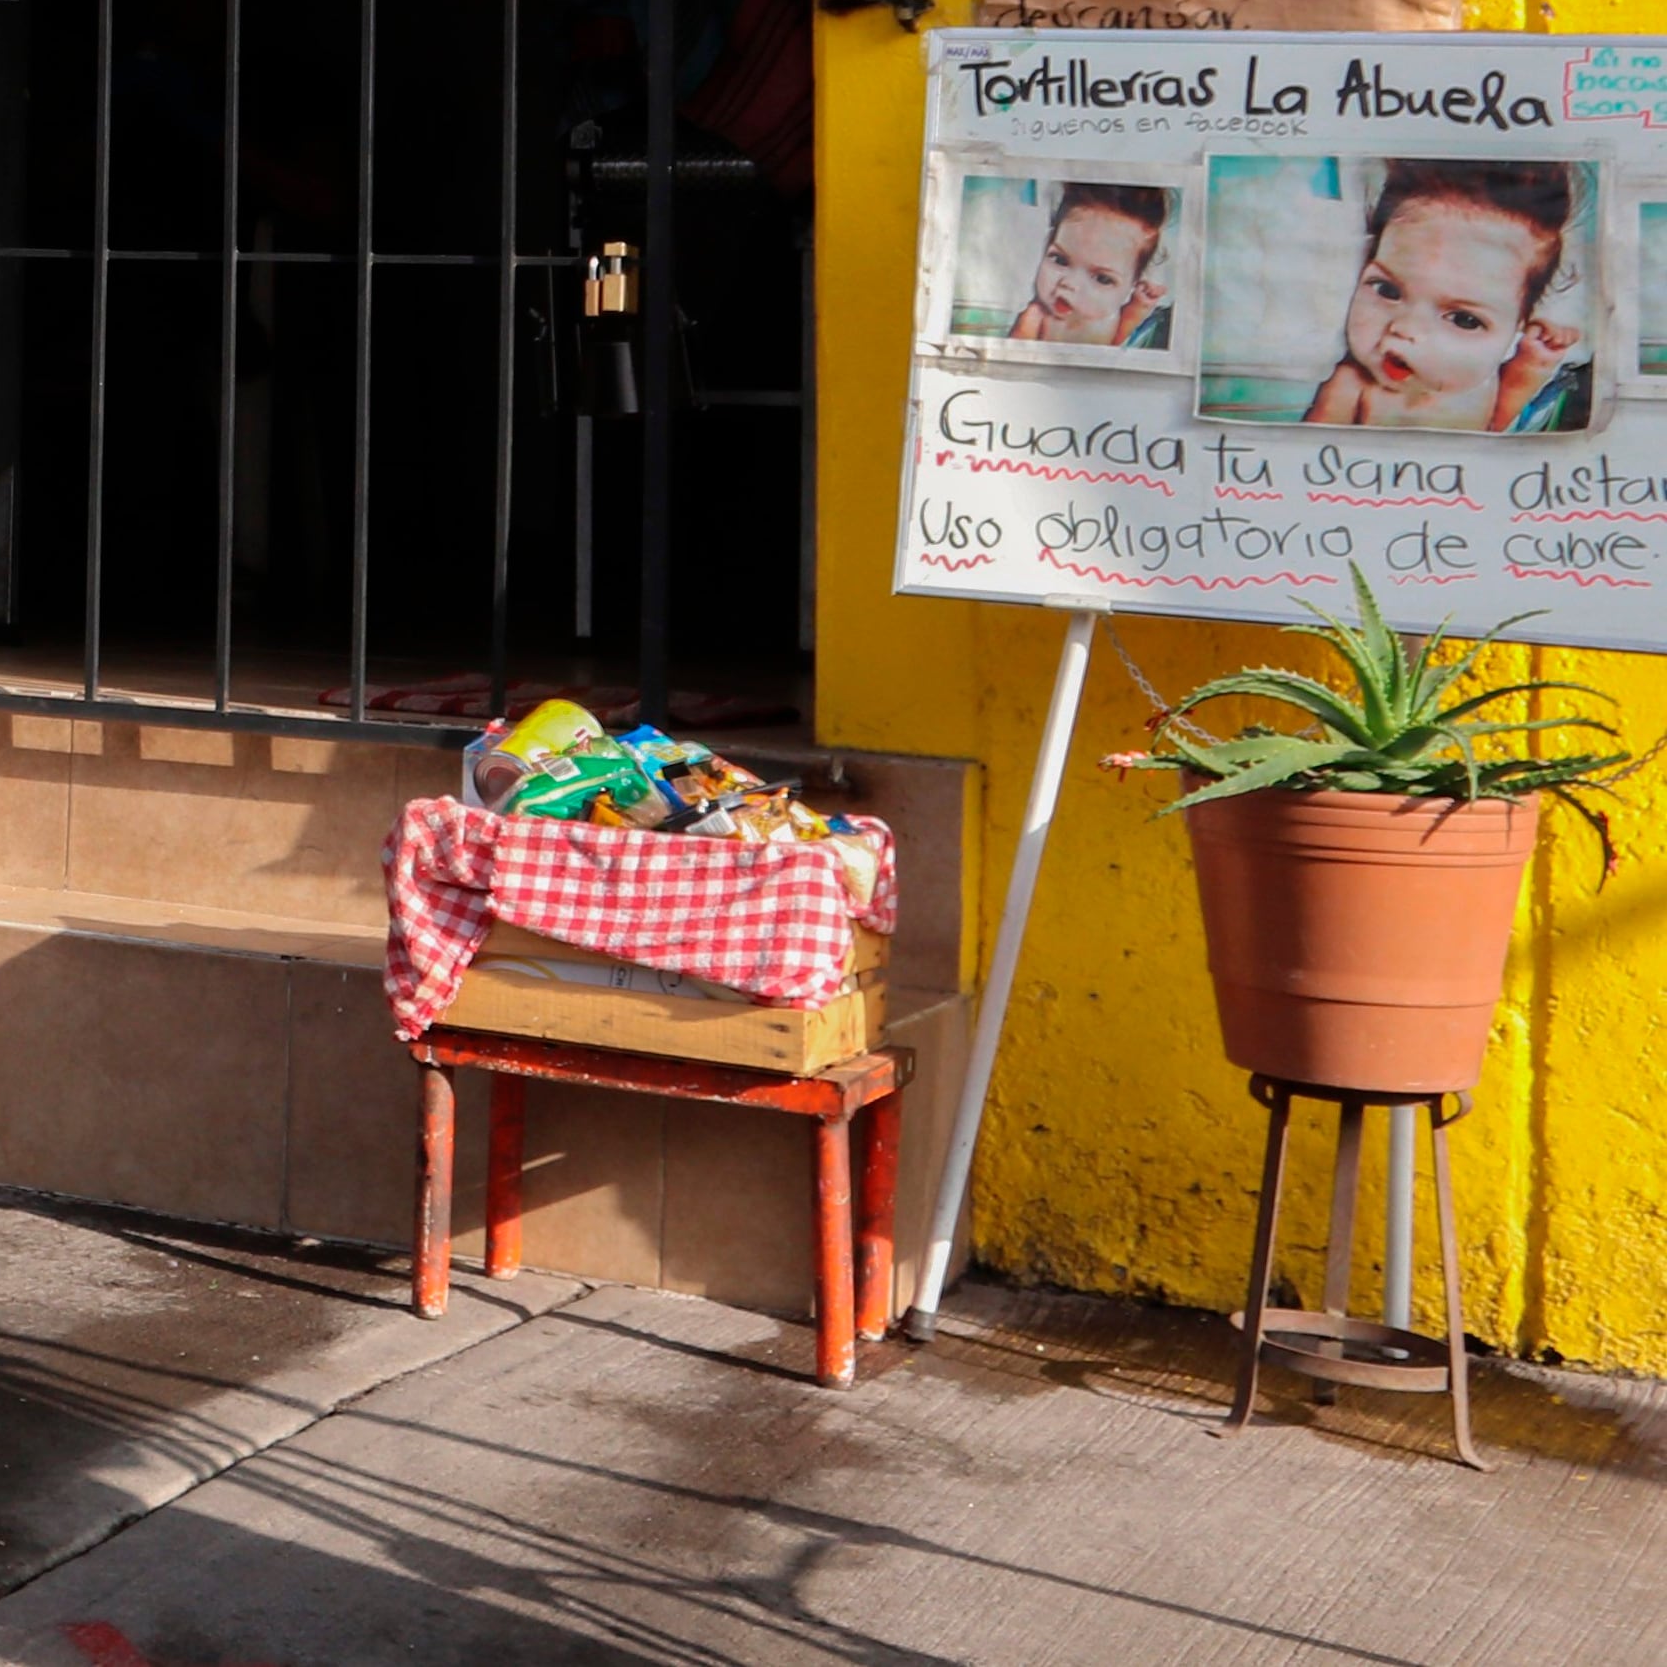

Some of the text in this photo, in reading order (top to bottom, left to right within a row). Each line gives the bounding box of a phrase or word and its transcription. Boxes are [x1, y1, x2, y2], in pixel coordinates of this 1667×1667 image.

[1246, 55, 1309, 116] La
[1336, 58, 1554, 131] Abuela
[939, 388, 1185, 475] Guarda
[1202, 433, 1273, 487] tu
[919, 497, 1003, 550] Uso
[1385, 520, 1478, 573] de
